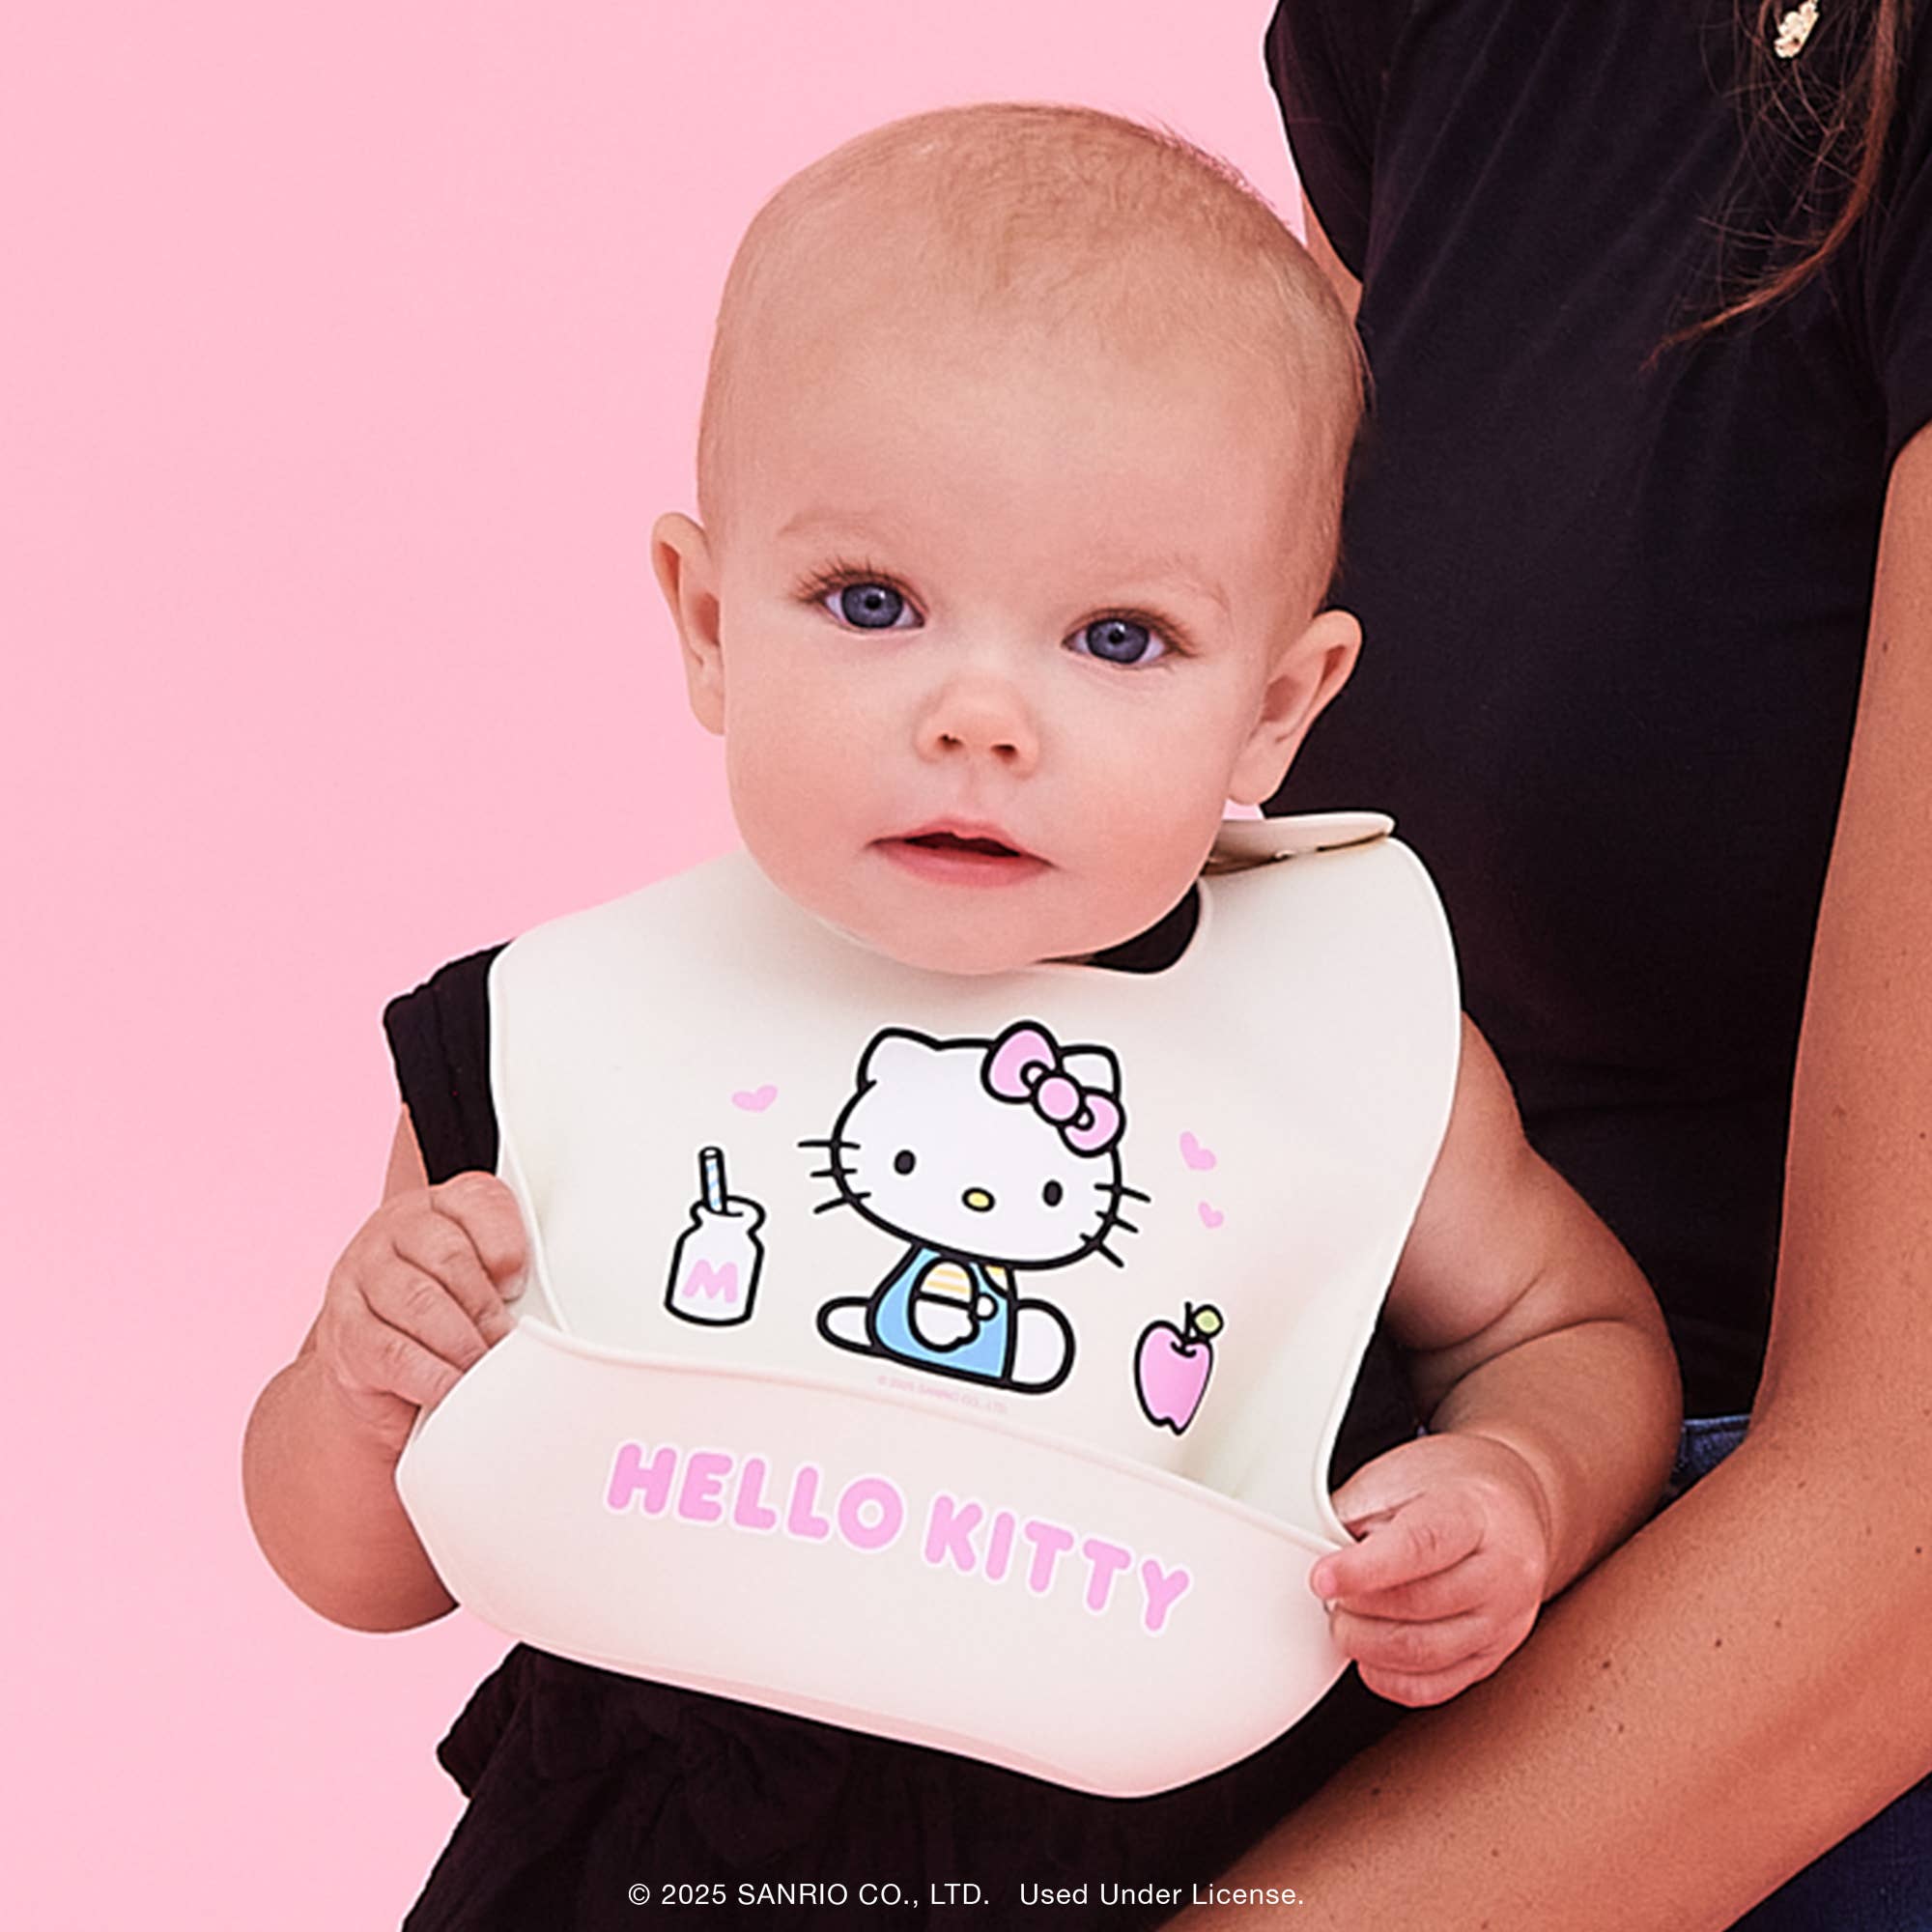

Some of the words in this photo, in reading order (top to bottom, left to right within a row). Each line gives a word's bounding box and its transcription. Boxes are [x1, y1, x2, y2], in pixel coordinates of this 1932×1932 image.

[682, 1259, 738, 1304] M
[606, 1441, 904, 1550] HELLO
[924, 1494, 1191, 1633] KITTY
